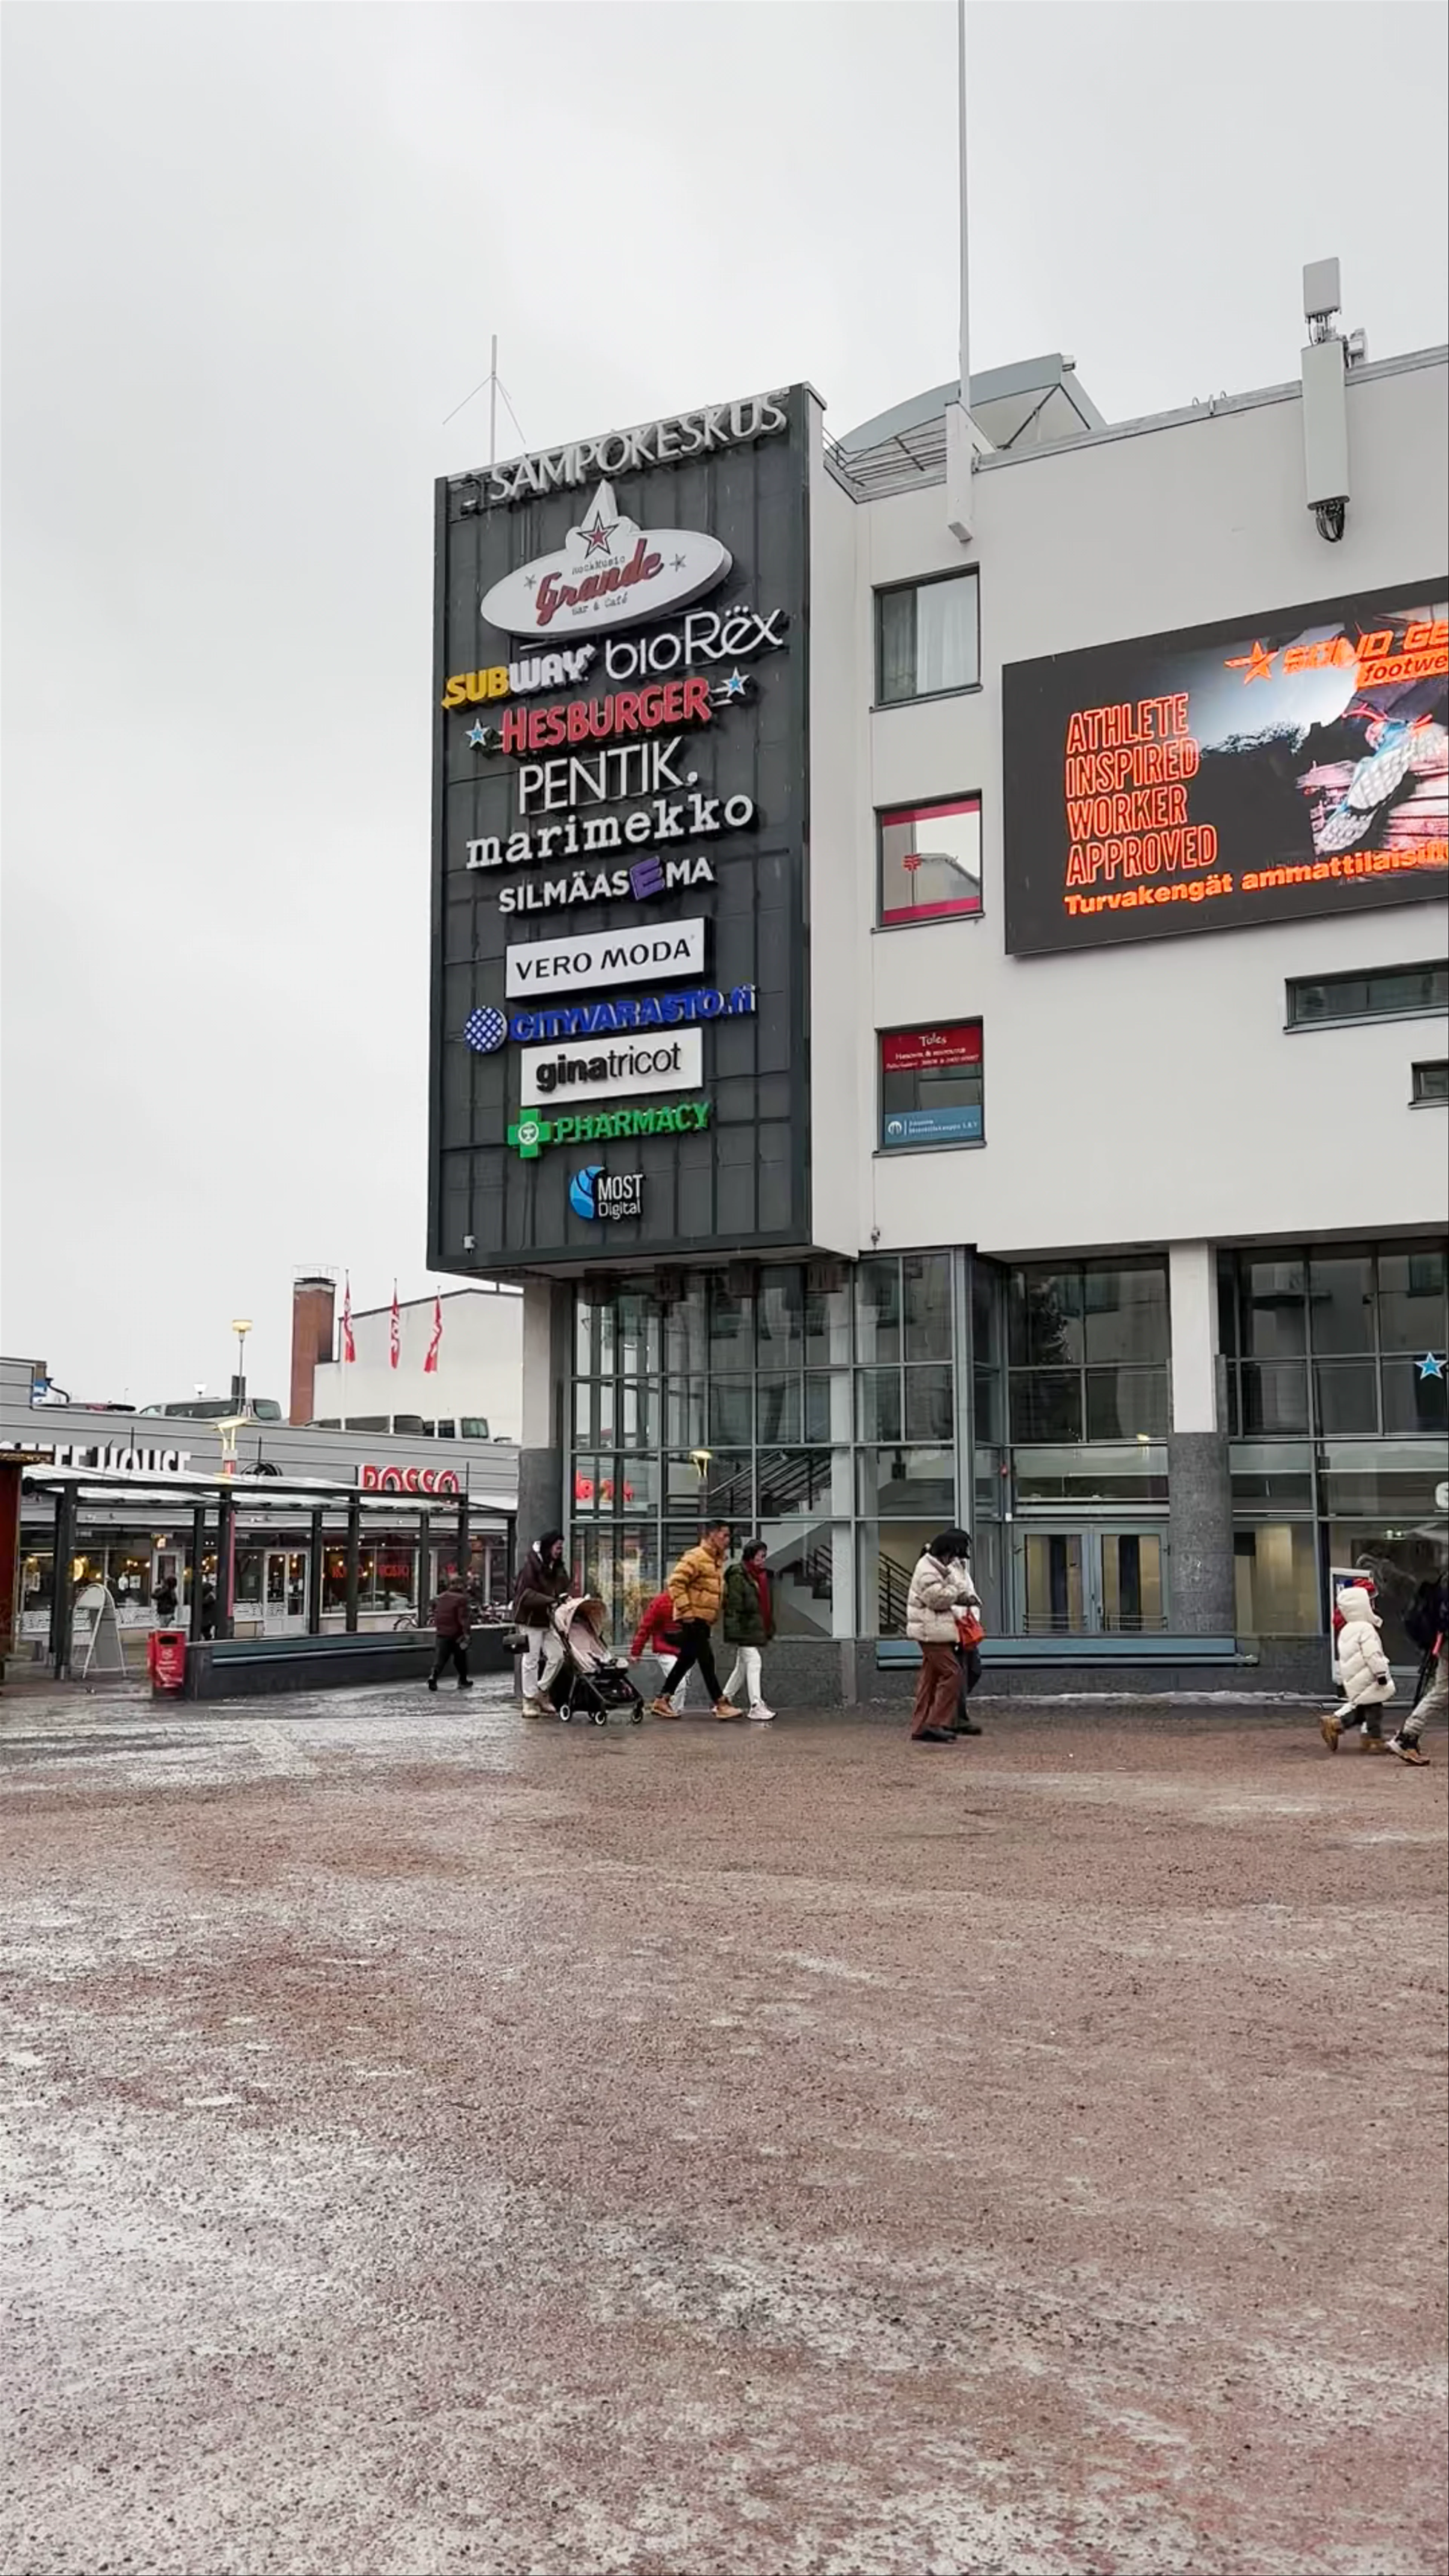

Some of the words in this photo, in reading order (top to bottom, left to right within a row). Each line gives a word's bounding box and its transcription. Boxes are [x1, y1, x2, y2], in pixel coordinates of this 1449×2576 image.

[490, 392, 788, 500] SAMPOKESKUS
[536, 538, 665, 626] Grande
[441, 643, 597, 709] SUBWAY
[501, 677, 712, 754] HESBURGER
[1067, 692, 1189, 754] ATHLETE
[519, 735, 698, 815] PENTIK.
[1066, 737, 1200, 798] INSPIRED
[466, 793, 754, 869] marimekko
[1067, 784, 1188, 841] WORKER
[498, 856, 714, 913] SILMÄASEMA
[1064, 873, 1233, 915] Turvakengät
[1241, 839, 1448, 890] ammattilaisill
[1066, 824, 1217, 887] APPROVED
[515, 952, 592, 980] VERO
[600, 938, 691, 970] MODA
[510, 984, 755, 1041] CITYVARASTO.fi
[536, 1042, 681, 1092] ginatricot
[557, 1101, 711, 1144] PHARMACY
[598, 1173, 643, 1201] MOST
[598, 1200, 641, 1220] Digital
